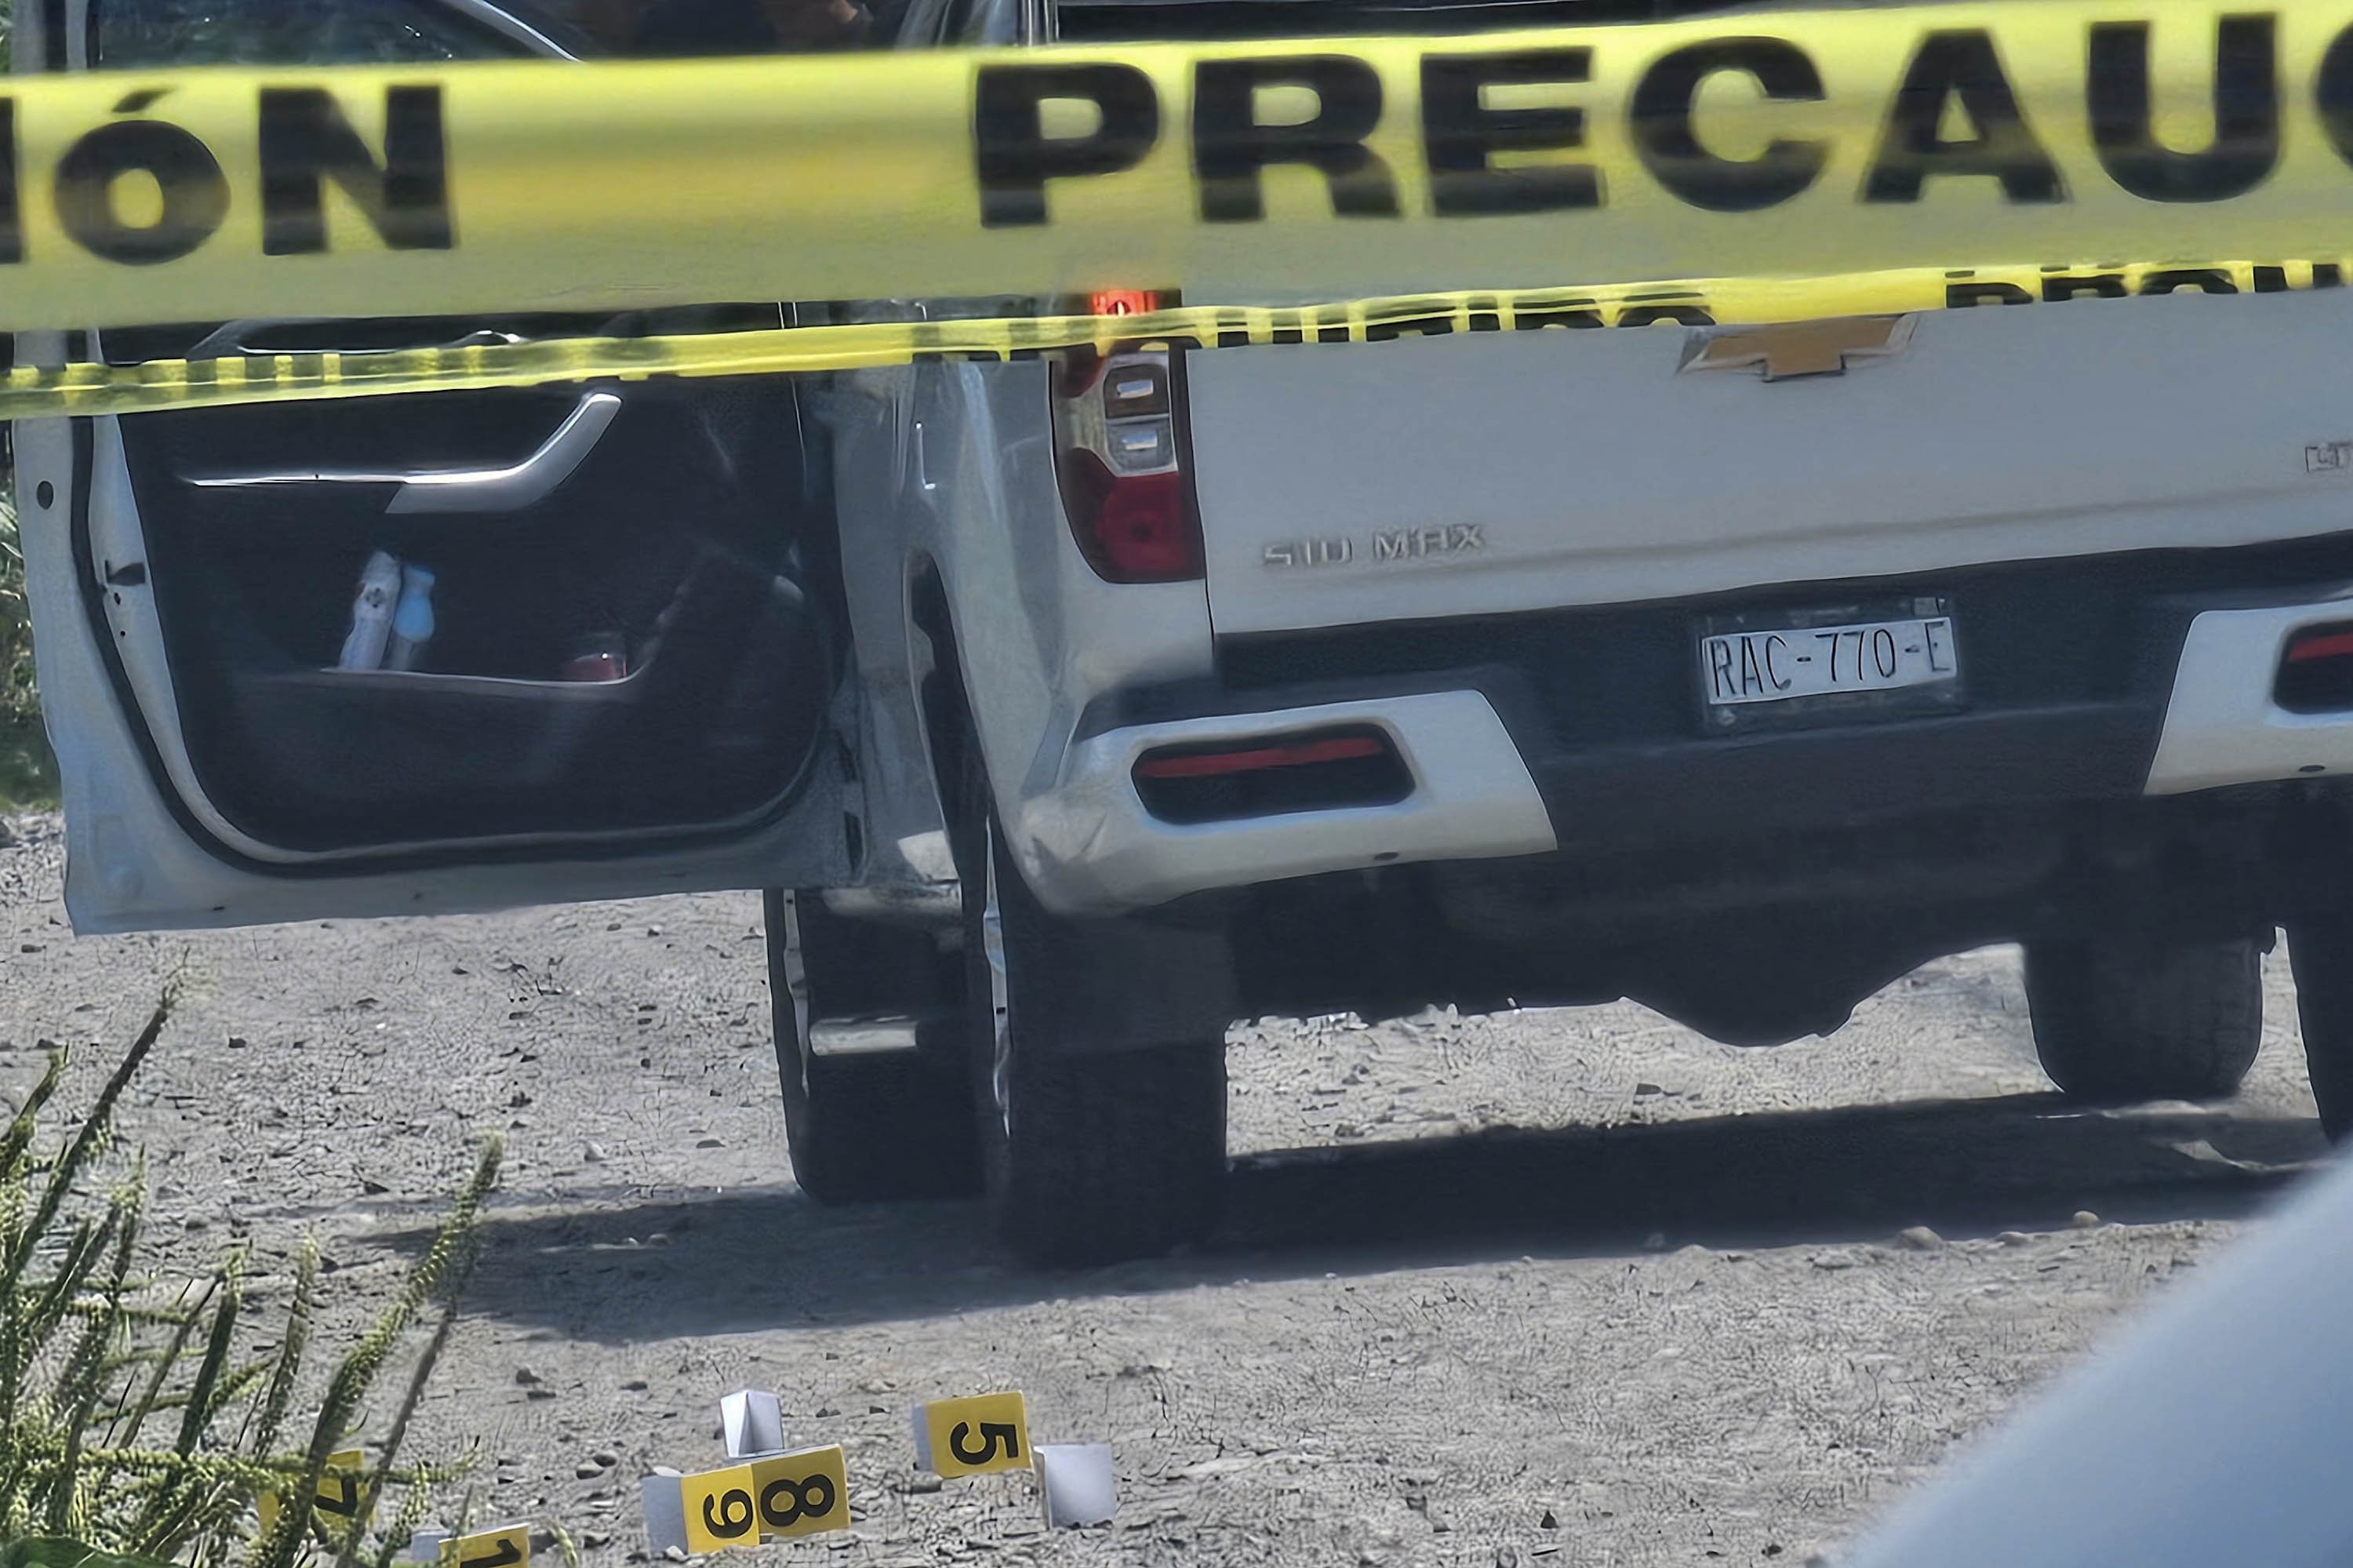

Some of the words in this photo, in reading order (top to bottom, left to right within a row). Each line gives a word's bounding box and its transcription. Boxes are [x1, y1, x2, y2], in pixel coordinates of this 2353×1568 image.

[975, 13, 2353, 228] PRECAU
[1371, 522, 1486, 562] MAX
[1710, 620, 1951, 697] RAC-770-E
[950, 1421, 1019, 1465] 5
[703, 1489, 754, 1538] 9
[760, 1474, 835, 1527] 8
